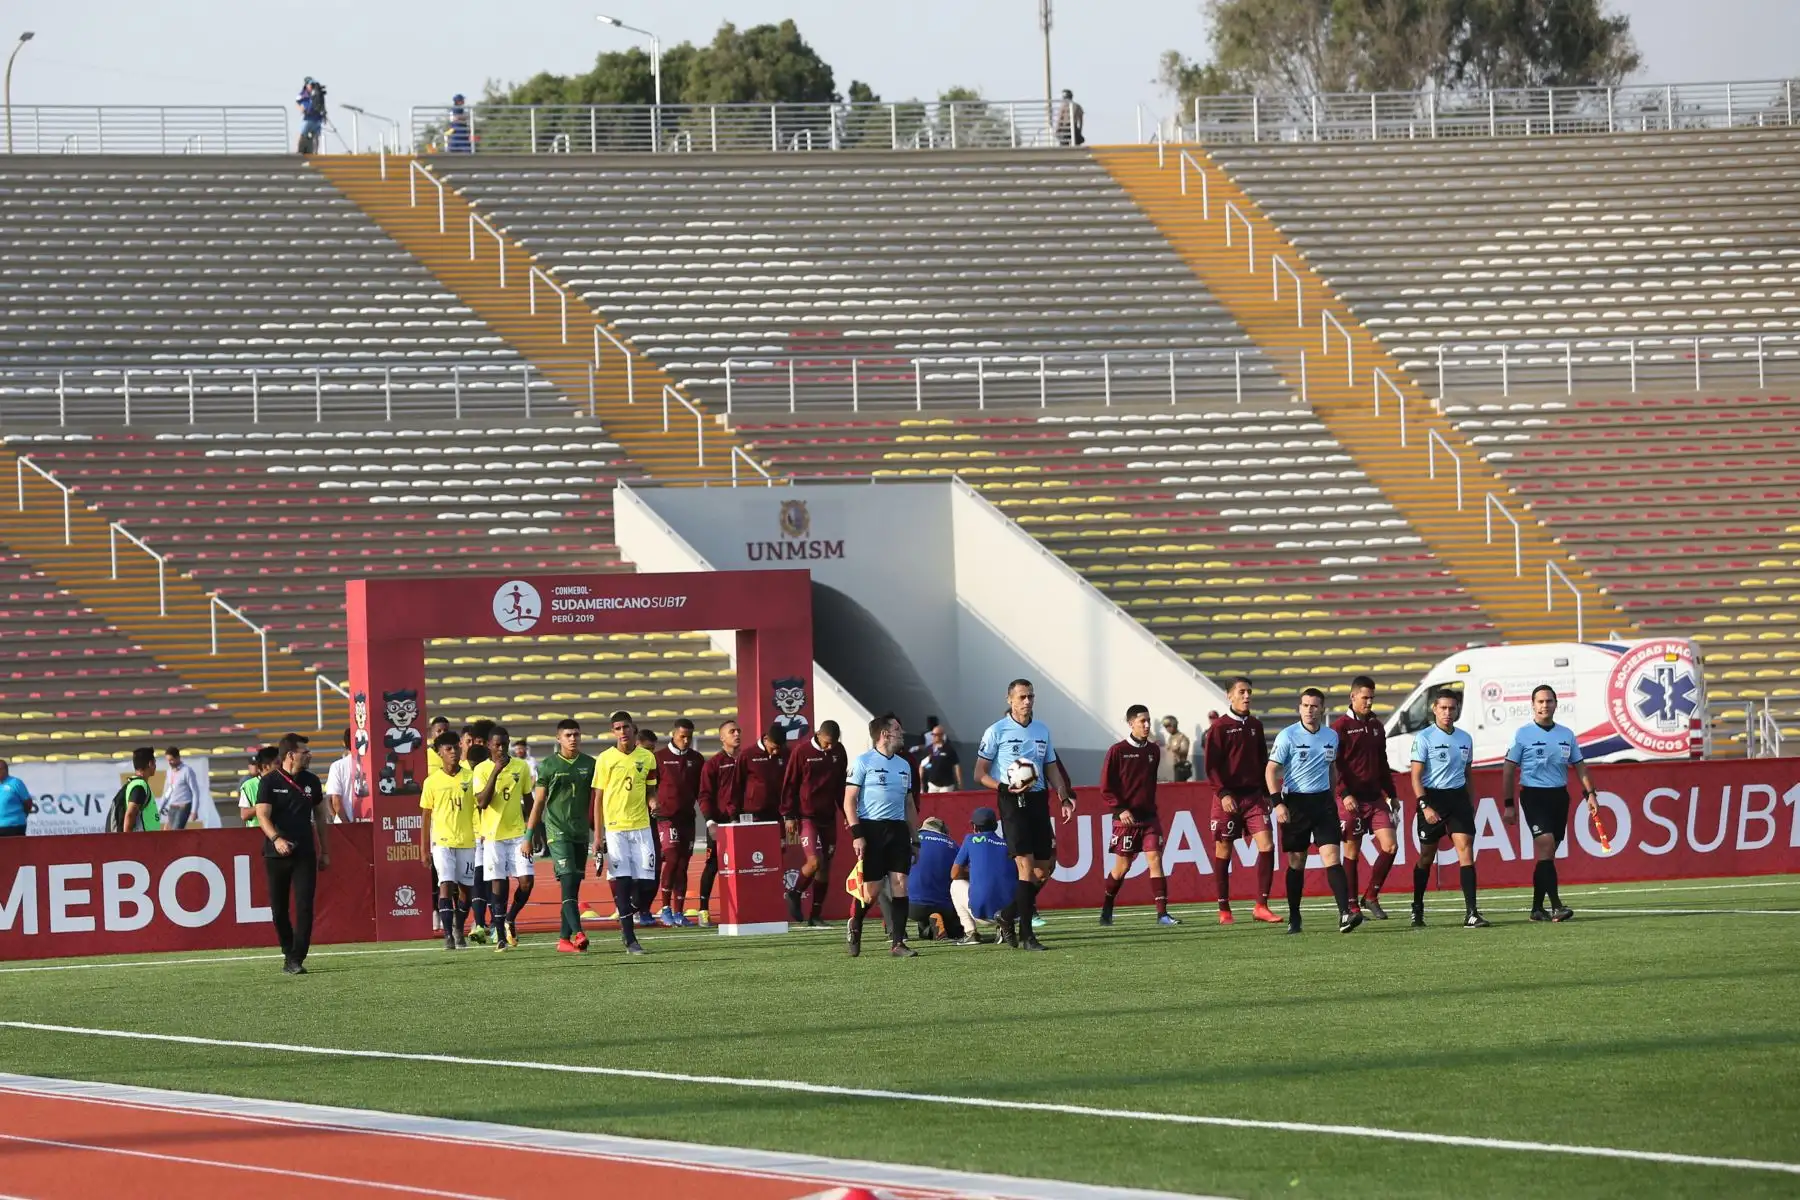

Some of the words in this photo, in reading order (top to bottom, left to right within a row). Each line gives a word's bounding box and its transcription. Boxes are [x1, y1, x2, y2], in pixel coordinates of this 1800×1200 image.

[746, 540, 845, 561] UNMSM
[552, 613, 574, 623] PERÚ
[575, 614, 595, 623] 2019
[1614, 645, 1663, 688] SOCIEDAD
[1612, 698, 1683, 750] PARAMÉDICOS
[625, 776, 633, 791] 3
[503, 787, 510, 802] 6
[450, 795, 462, 811] 14
[382, 816, 394, 830] EL
[1227, 820, 1234, 834] 9
[1355, 818, 1362, 831] 3
[394, 829, 411, 843] DEL
[669, 827, 678, 840] 19
[1123, 835, 1133, 849] 15
